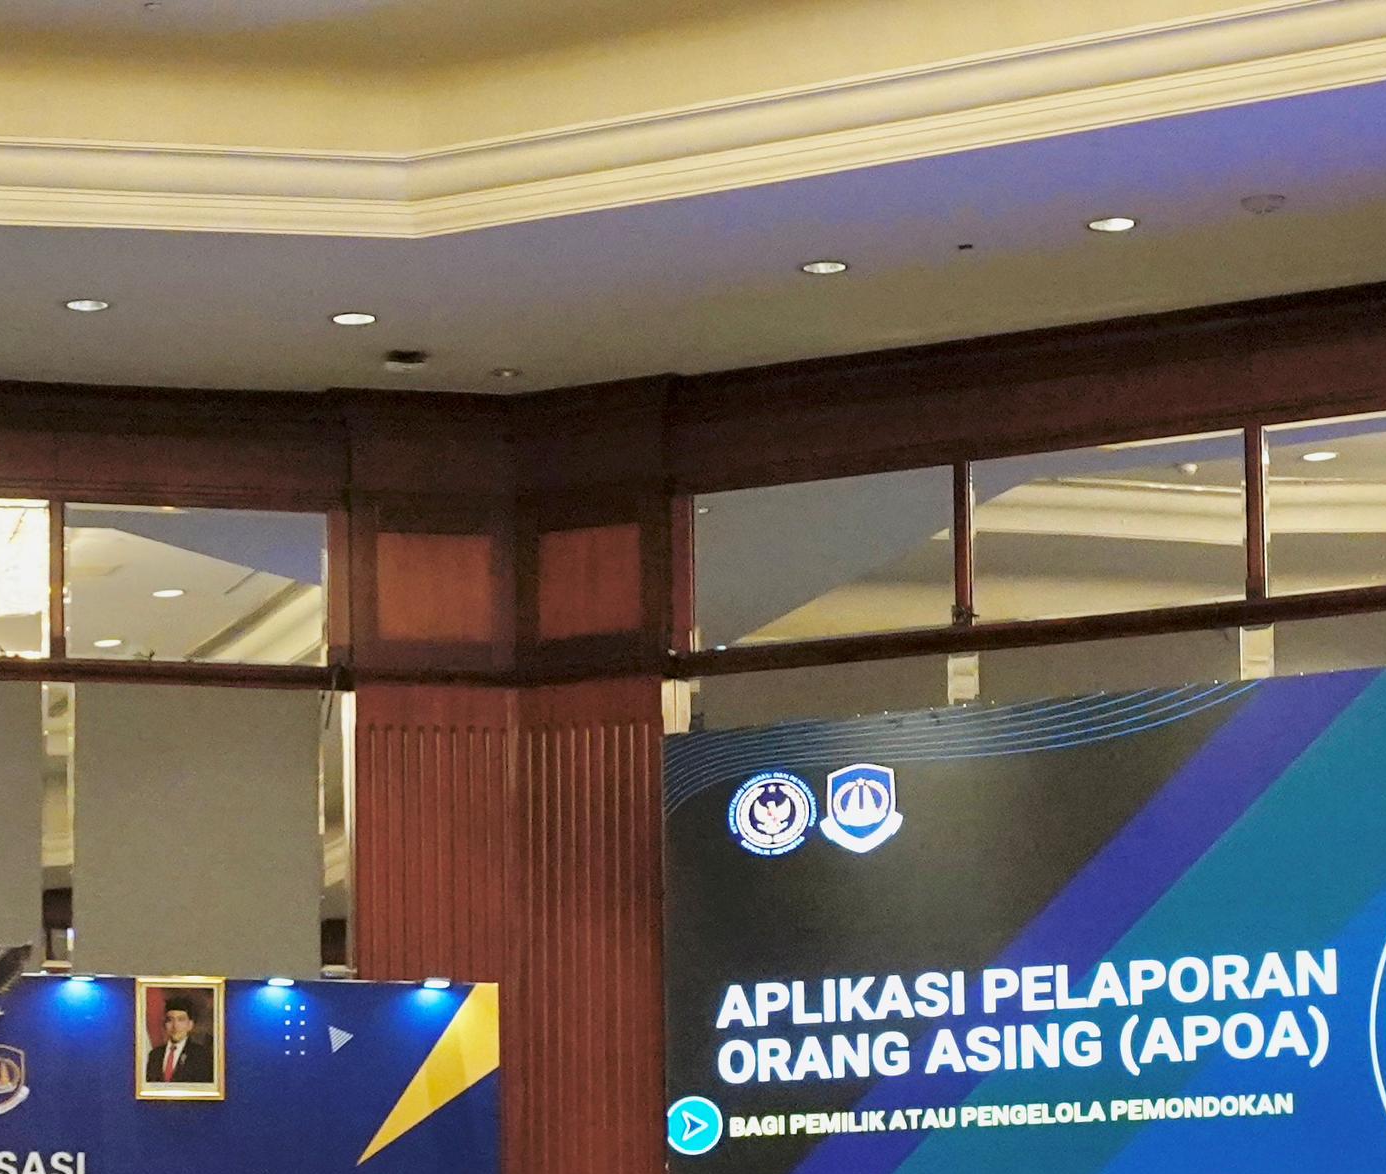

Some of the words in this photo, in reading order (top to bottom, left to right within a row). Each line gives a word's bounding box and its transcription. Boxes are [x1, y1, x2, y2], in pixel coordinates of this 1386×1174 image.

[716, 971, 965, 1028] APLIKASI
[982, 949, 1338, 1014] PELAPORAN
[717, 1031, 911, 1084] ORANG
[925, 1021, 1103, 1076] ASING
[1119, 1005, 1330, 1076] (APOA)
[729, 1114, 786, 1138] BAGI
[789, 1111, 886, 1135] PEMILIK
[888, 1106, 956, 1131] ATAU
[960, 1101, 1106, 1128] PENGELOLA
[1111, 1093, 1294, 1121] PEMONDOKAN
